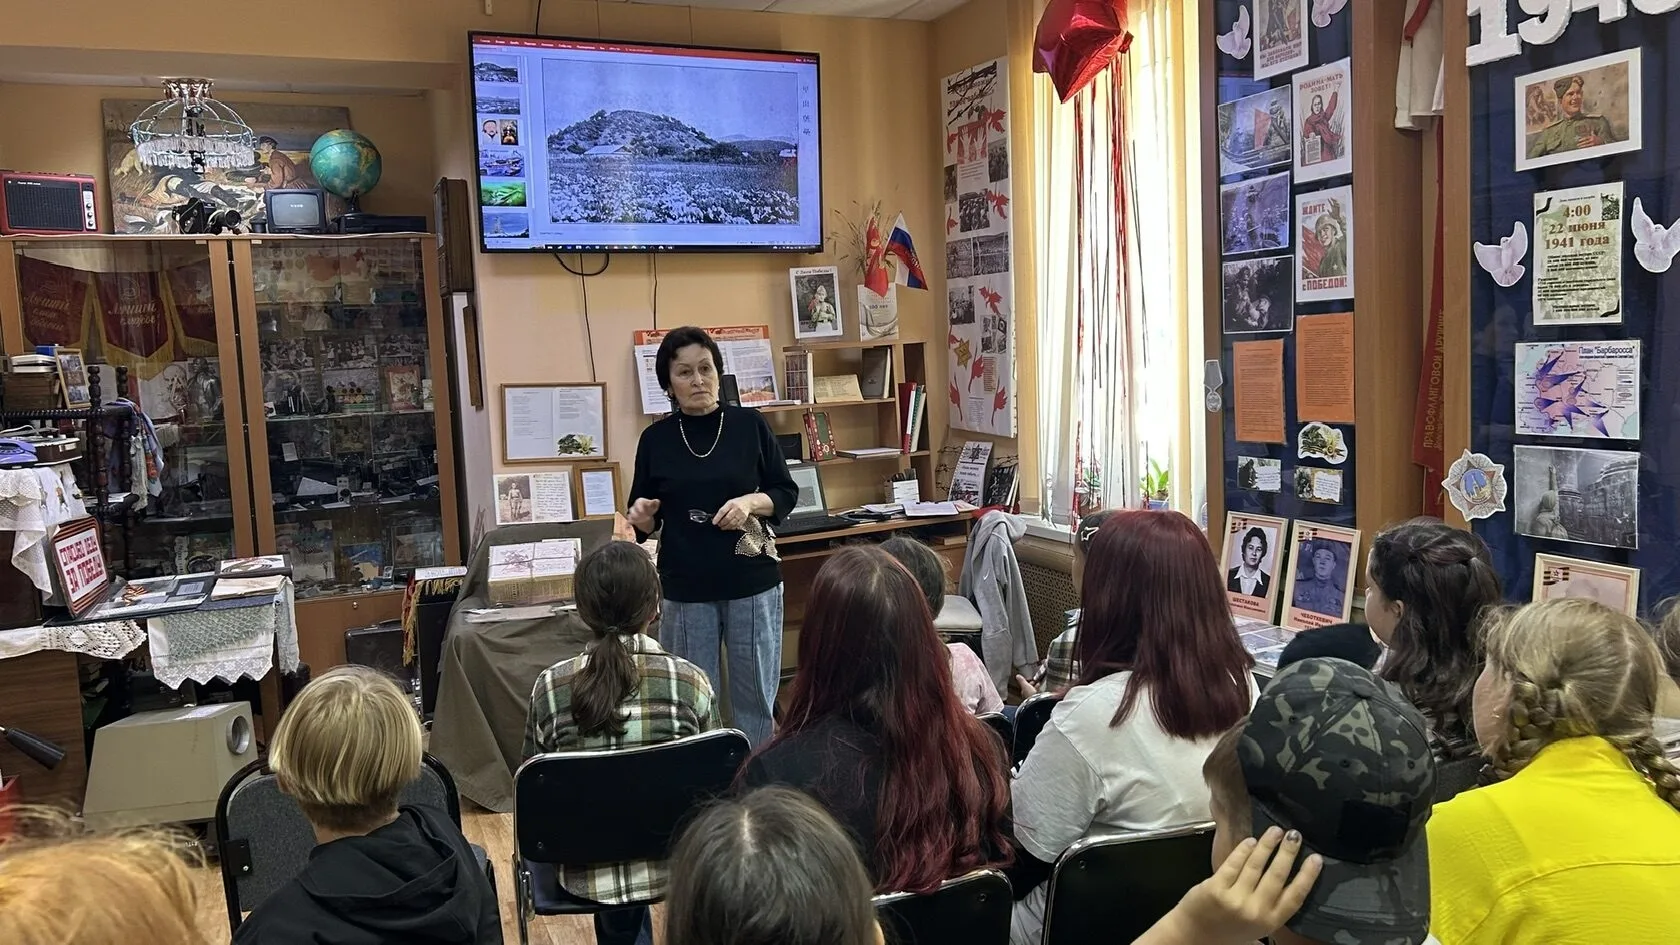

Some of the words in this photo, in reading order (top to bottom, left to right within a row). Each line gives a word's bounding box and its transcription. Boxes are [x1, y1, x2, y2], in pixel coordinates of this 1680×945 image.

[1300, 73, 1343, 90] РОДИНА-МАТЬ
[1302, 204, 1326, 215] ЖДИТЕ
[1562, 204, 1591, 218] 4:00
[1549, 223, 1564, 235] 22
[1568, 221, 1606, 233] июня
[1545, 236, 1574, 249] 1941
[1580, 235, 1610, 247] года
